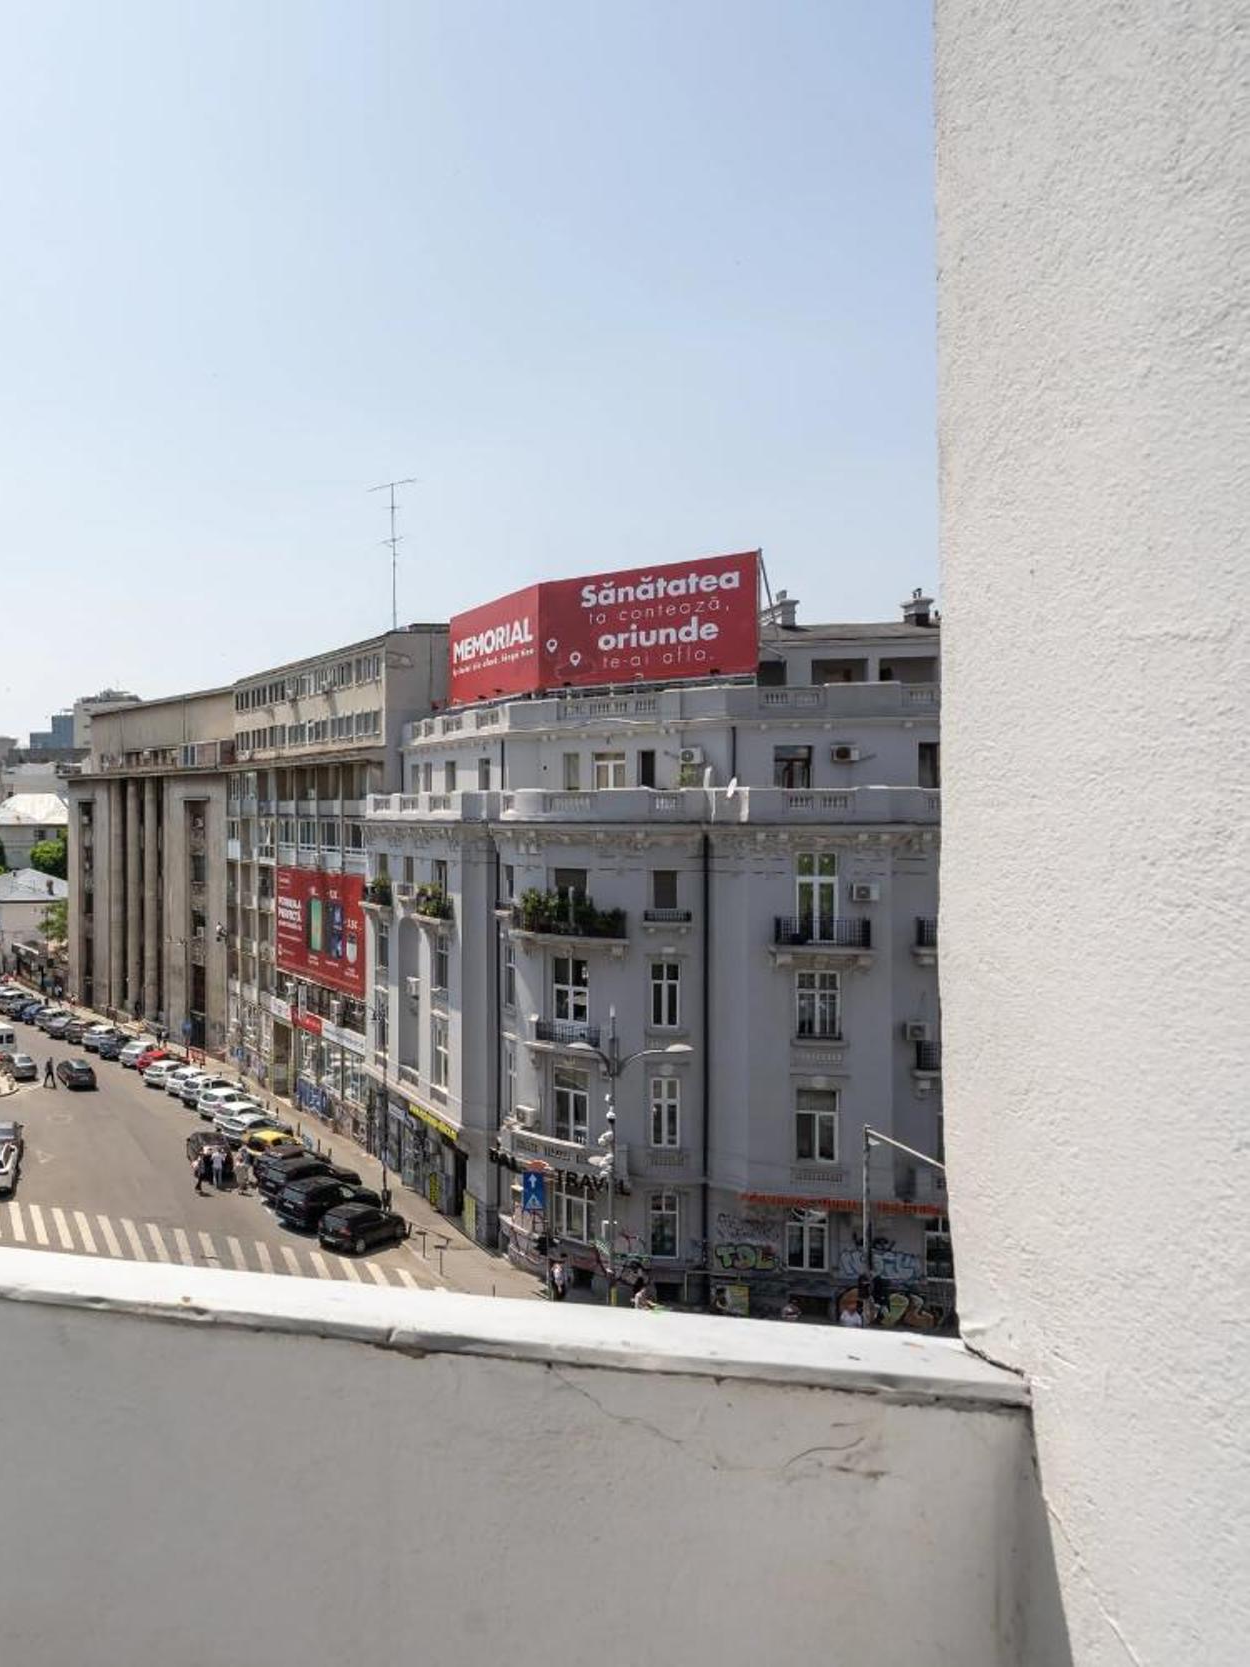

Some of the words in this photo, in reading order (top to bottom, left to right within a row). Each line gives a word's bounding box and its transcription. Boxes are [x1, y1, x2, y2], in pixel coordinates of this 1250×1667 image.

[581, 571, 740, 608] Sănătatea
[589, 612, 607, 625] ta
[598, 616, 719, 650] oriunde
[453, 616, 533, 665] MEMORIAL
